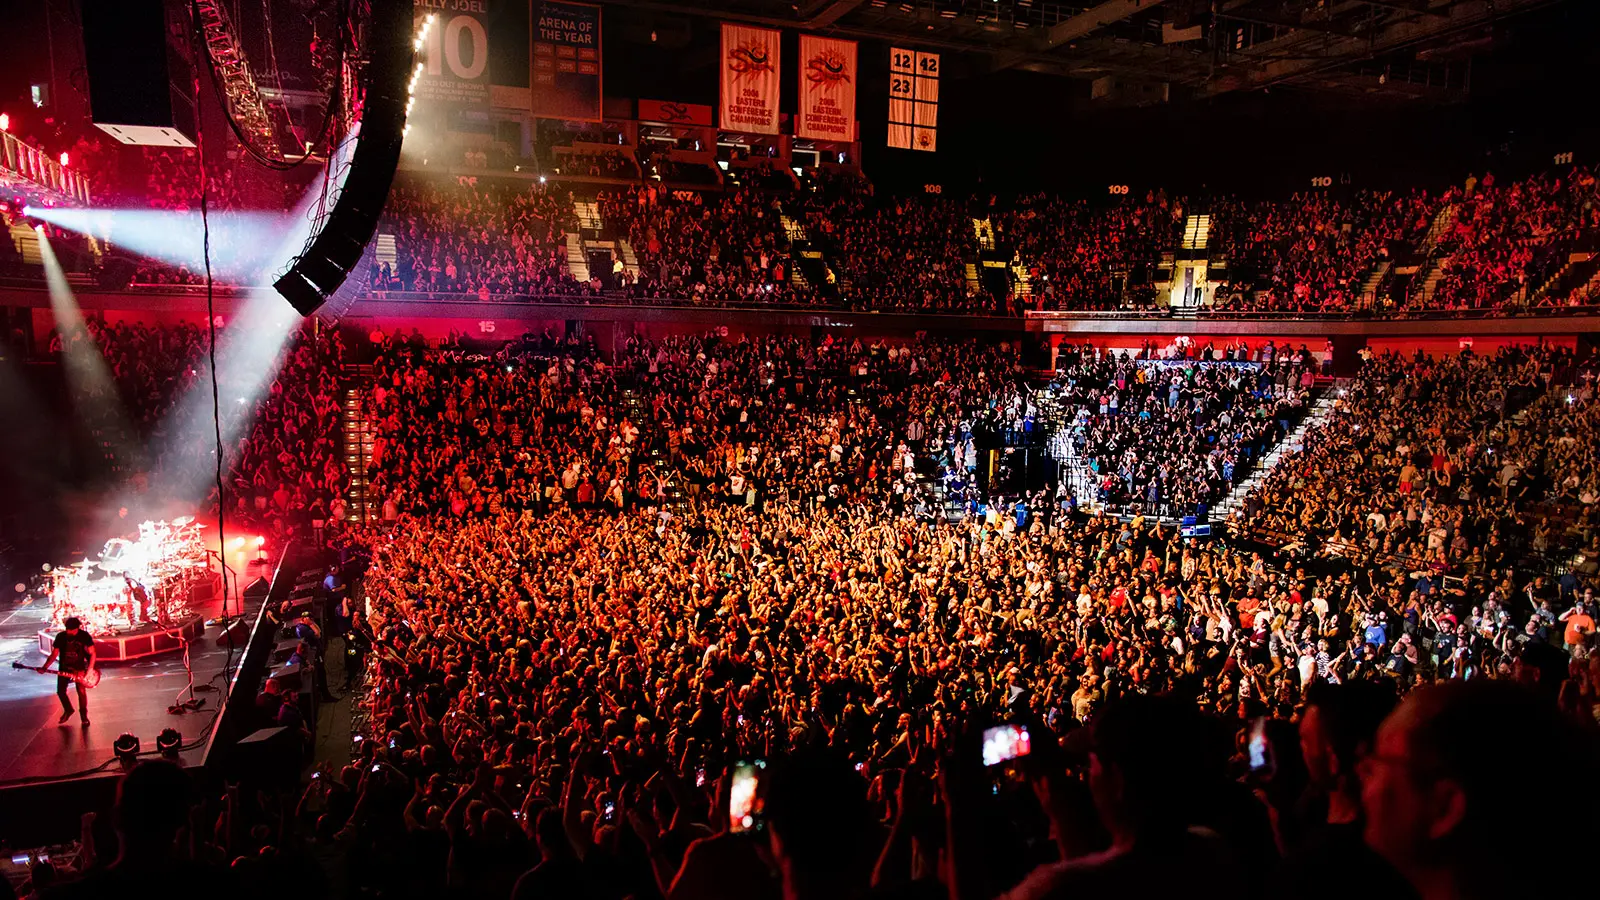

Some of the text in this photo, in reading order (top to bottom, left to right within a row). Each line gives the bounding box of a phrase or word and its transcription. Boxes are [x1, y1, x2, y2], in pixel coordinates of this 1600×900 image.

[451, 0, 486, 13] JOEL
[539, 16, 592, 32] ARENA OF
[540, 28, 592, 43] THE YEAR
[414, 14, 487, 79] 10
[894, 54, 910, 68] 12
[920, 57, 937, 72] 42
[892, 79, 910, 93] 23
[736, 97, 765, 107] EASTERN
[729, 105, 772, 117] CONFERENCE
[813, 106, 841, 116] EASTERN
[730, 114, 771, 126] CHAMPIONS
[806, 114, 847, 125] CONFERENCE
[807, 122, 846, 134] CHAMPIONS
[1554, 152, 1573, 165] 111
[1311, 177, 1332, 187] 110
[924, 184, 941, 194] 108
[1108, 185, 1129, 194] 109
[478, 320, 496, 333] 15
[443, 350, 490, 363] Moegan
